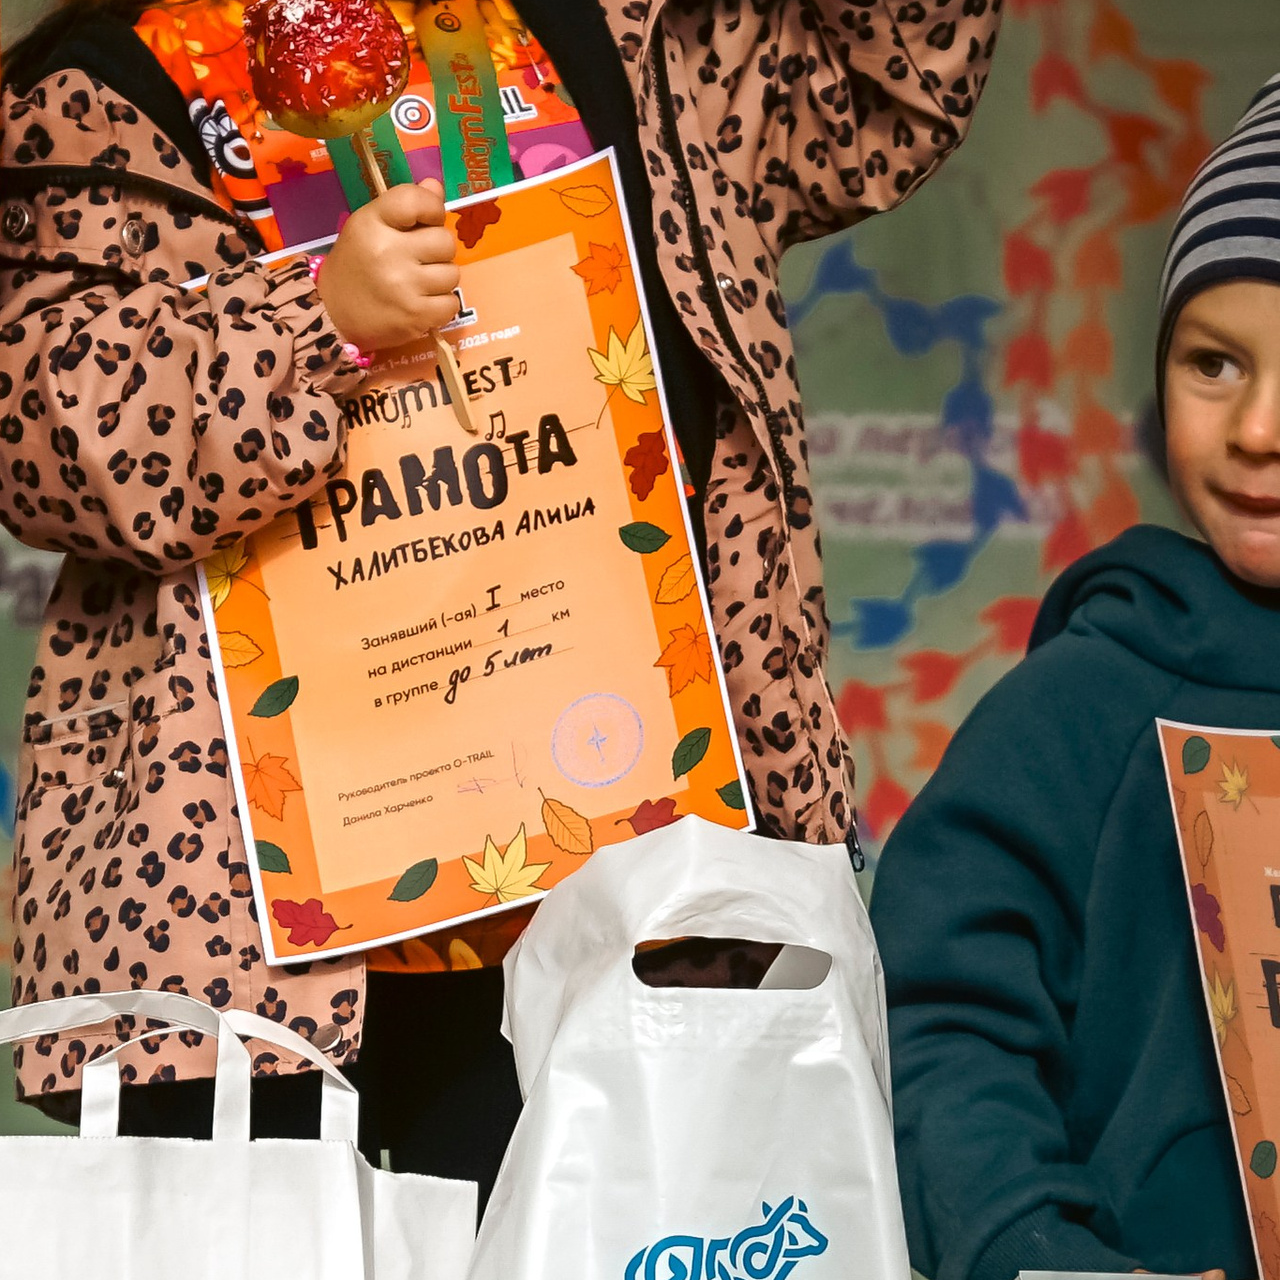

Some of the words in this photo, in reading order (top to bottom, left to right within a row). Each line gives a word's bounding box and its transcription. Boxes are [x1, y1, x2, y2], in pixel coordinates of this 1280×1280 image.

[458, 332, 489, 350] 2025
[490, 325, 521, 342] года
[327, 520, 505, 590] ХАЛИТБЕКОВА
[361, 618, 438, 650] Занявший
[441, 603, 477, 627] (-ая)
[520, 579, 565, 602] место
[368, 665, 387, 679] на
[391, 638, 472, 673] дистанции
[497, 619, 509, 637] 1
[551, 608, 570, 623] км
[374, 697, 383, 708] в
[386, 679, 439, 706] группе
[444, 665, 471, 704] до
[483, 649, 502, 676] 5
[504, 643, 552, 669] лет
[337, 776, 408, 802] Руководитель
[409, 762, 452, 783] проекта
[453, 750, 495, 769] O-TRAIL
[342, 807, 382, 827] Данила
[383, 794, 434, 815] Харченко
